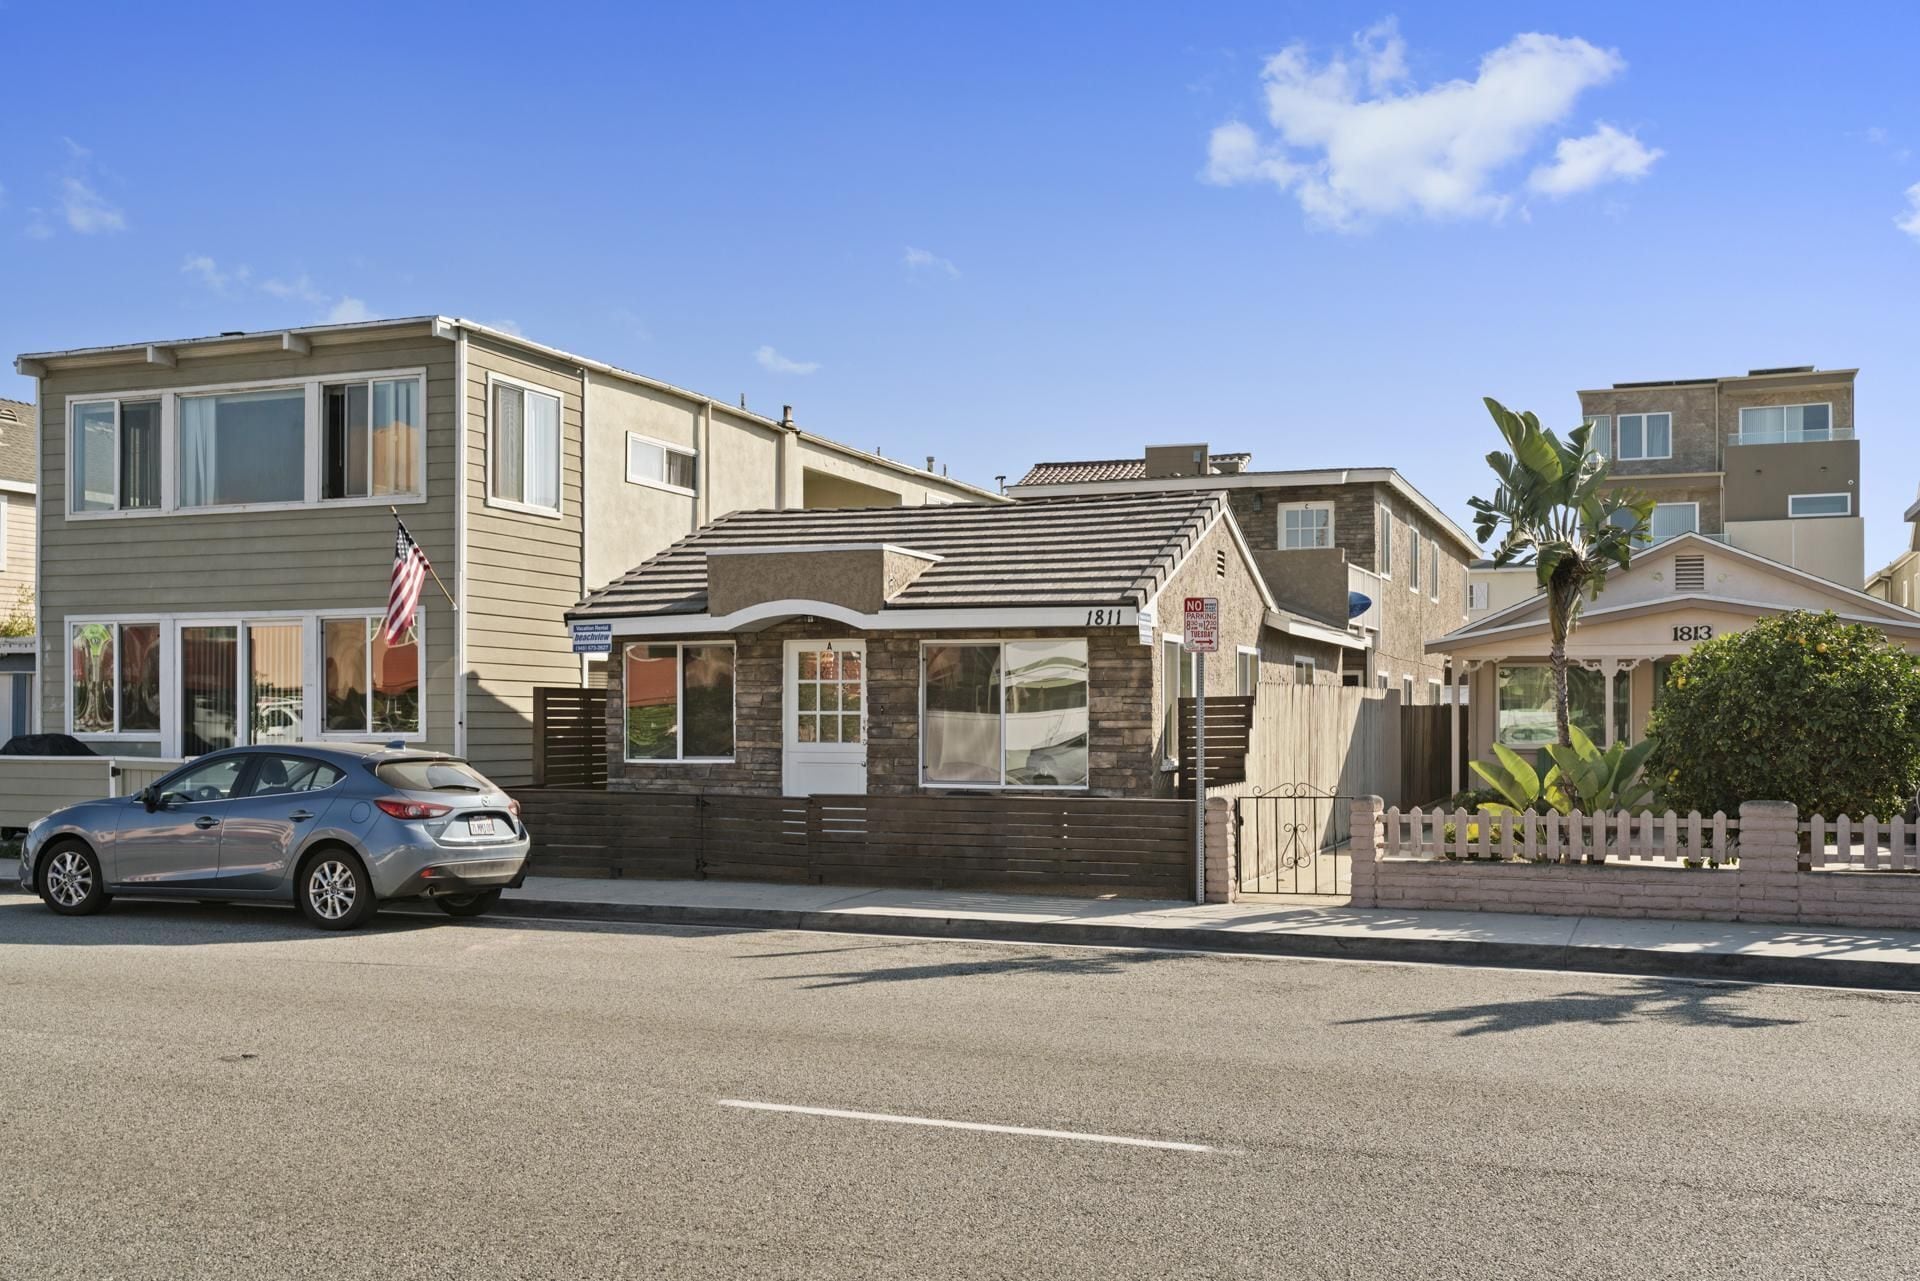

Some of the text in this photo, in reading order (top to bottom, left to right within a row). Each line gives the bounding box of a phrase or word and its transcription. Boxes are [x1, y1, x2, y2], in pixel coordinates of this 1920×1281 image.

[1186, 601, 1202, 611] NO
[1086, 609, 1121, 626] 1811
[1186, 612, 1217, 620] PARKING
[575, 633, 610, 641] beachview
[1191, 630, 1213, 638] TUESDAY
[1672, 625, 1712, 641] 1813
[826, 641, 833, 650] A
